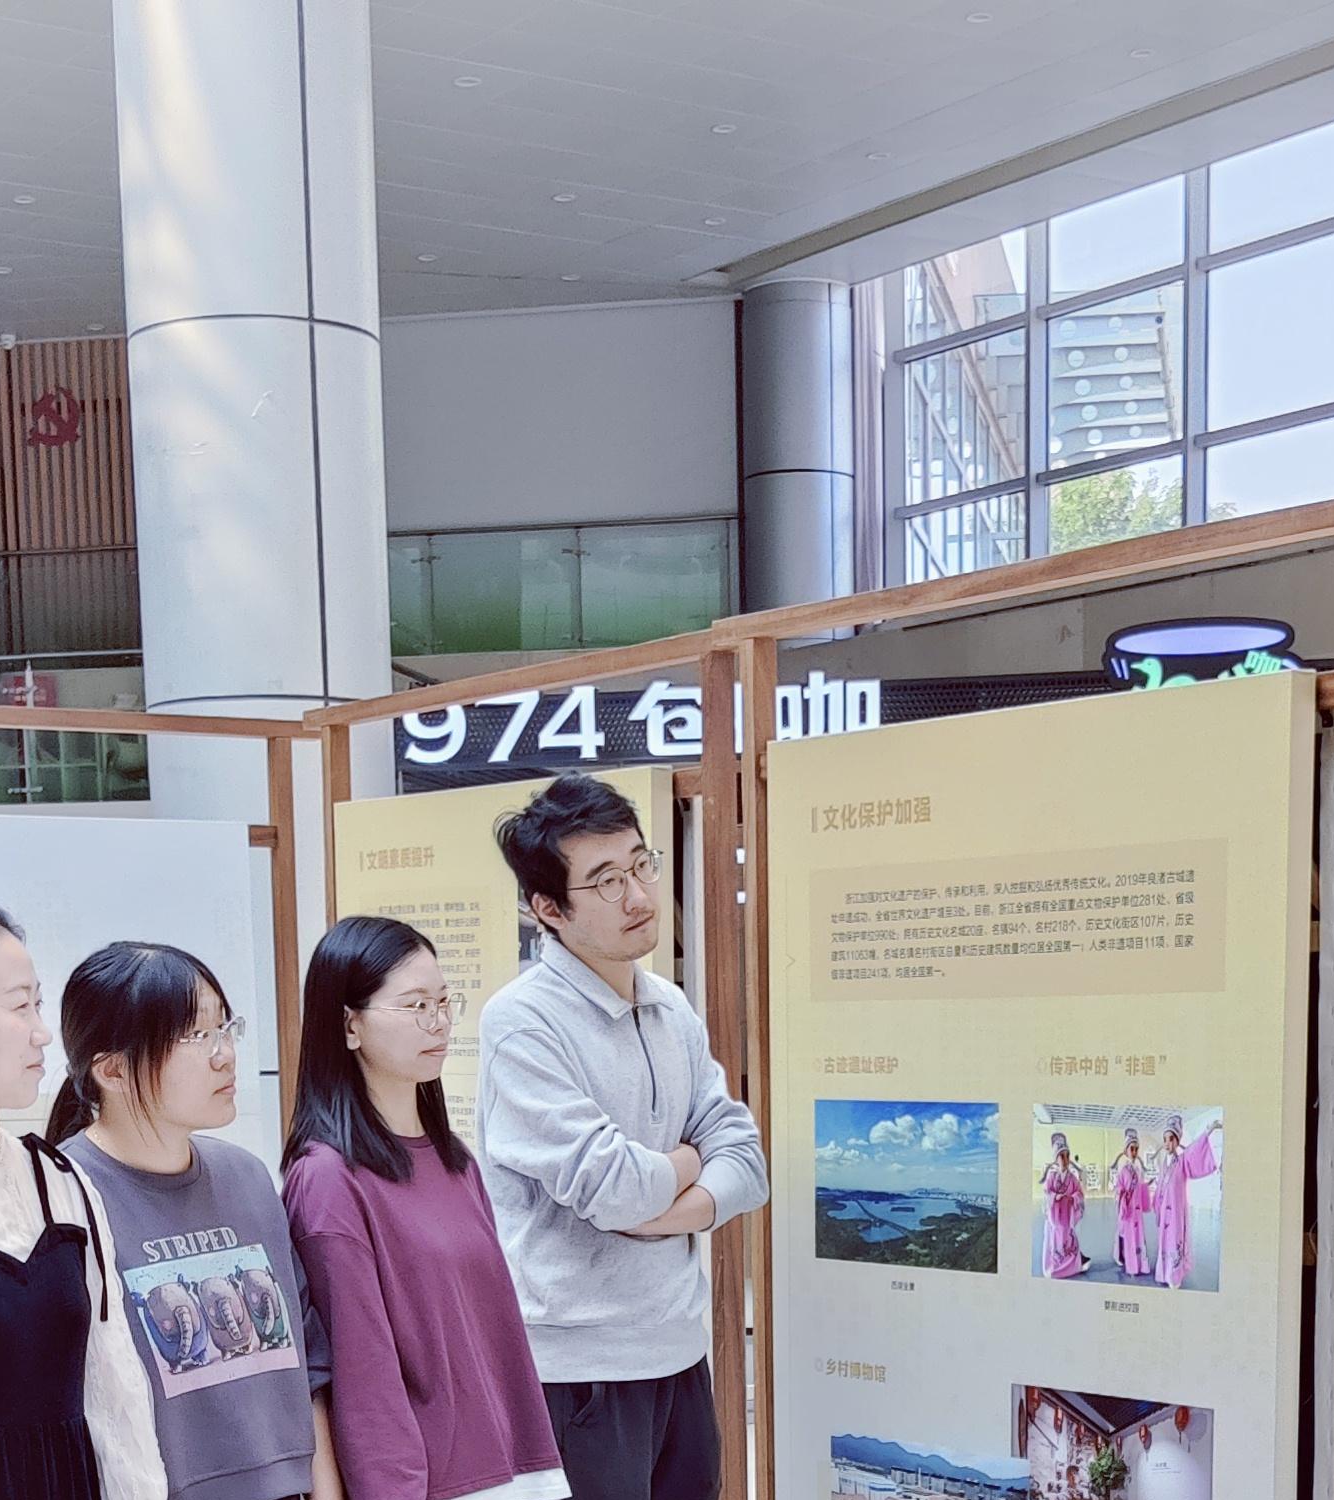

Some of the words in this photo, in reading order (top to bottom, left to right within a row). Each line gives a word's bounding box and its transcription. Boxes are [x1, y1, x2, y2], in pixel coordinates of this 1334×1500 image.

[823, 796, 932, 832] 文化保护加强
[824, 1056, 899, 1075] 古迹遗址保护
[142, 1226, 238, 1264] STRIPED
[825, 1358, 887, 1384] 乡村博物馆
